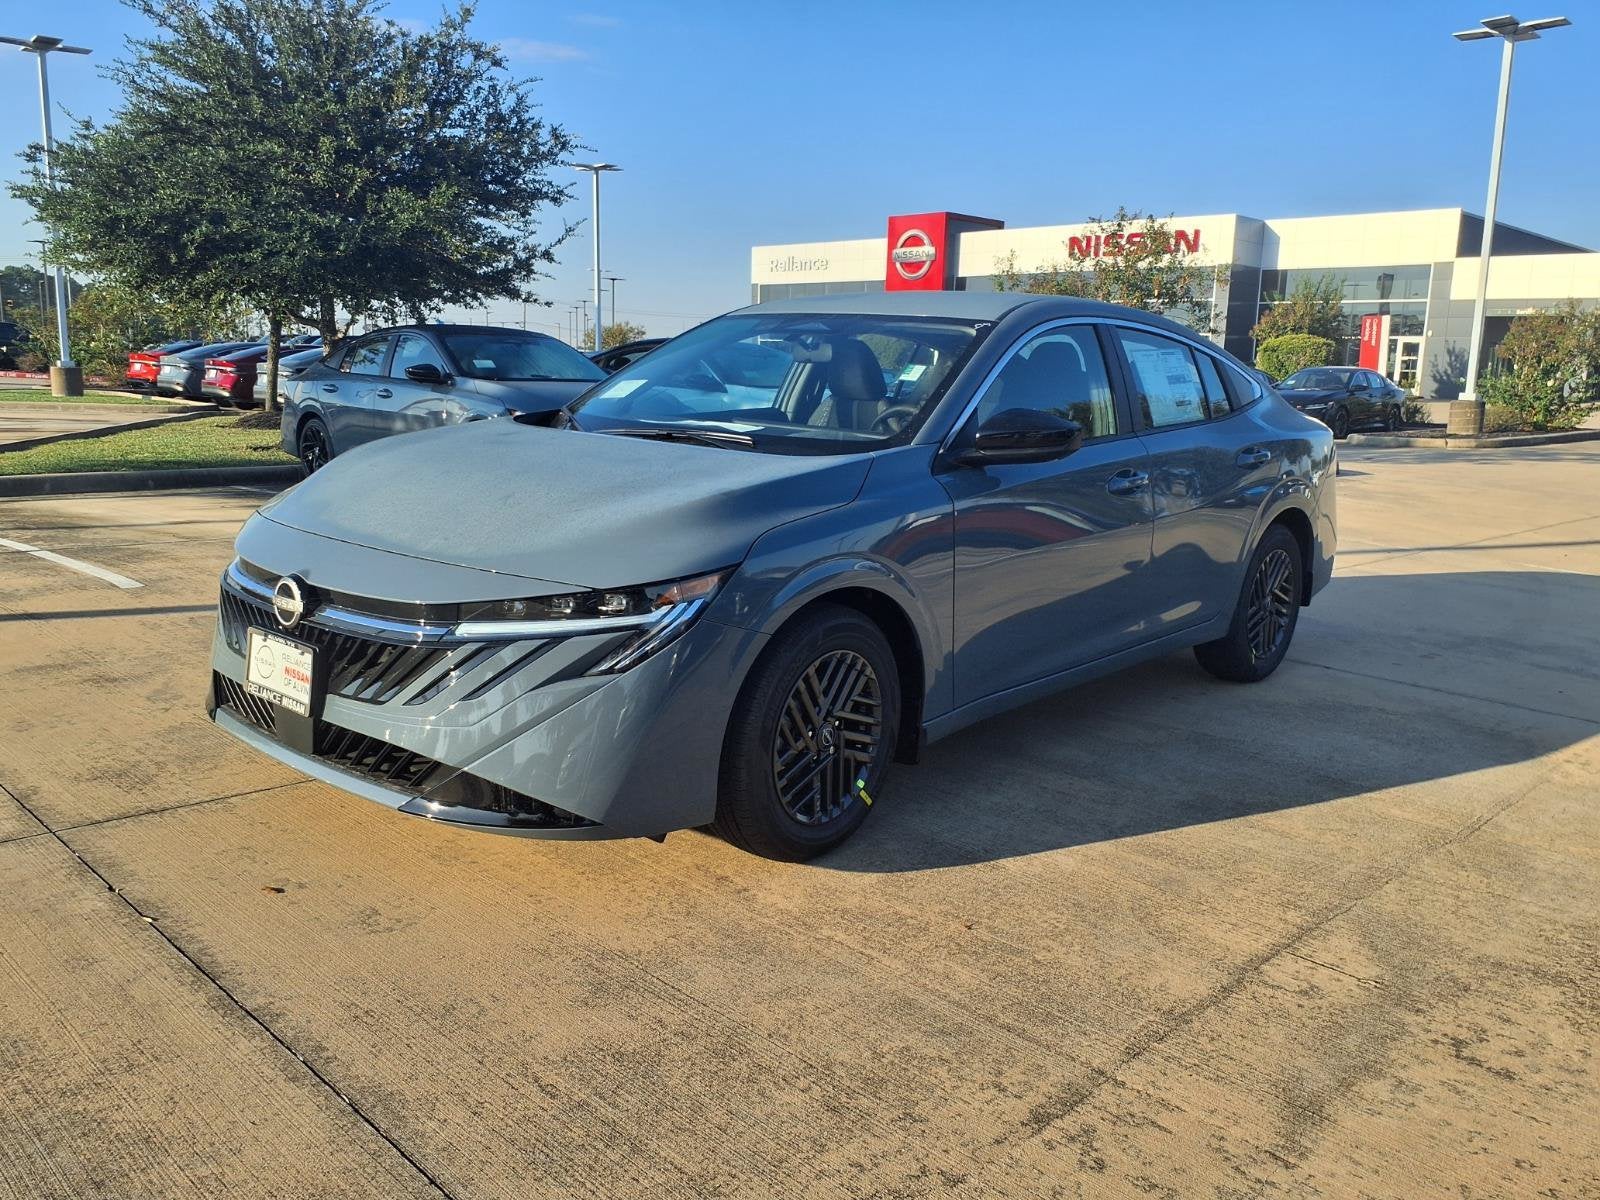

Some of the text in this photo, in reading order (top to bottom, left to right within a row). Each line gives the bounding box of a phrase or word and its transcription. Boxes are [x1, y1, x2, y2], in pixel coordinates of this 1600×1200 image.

[894, 250, 930, 259] NISSAN
[769, 256, 829, 273] Reliance
[1371, 318, 1379, 346] Customer
[281, 652, 311, 671] RELIANCE
[283, 677, 292, 687] OF
[284, 665, 310, 684] NISSAN
[247, 682, 306, 715] RELIANCE NISSAN
